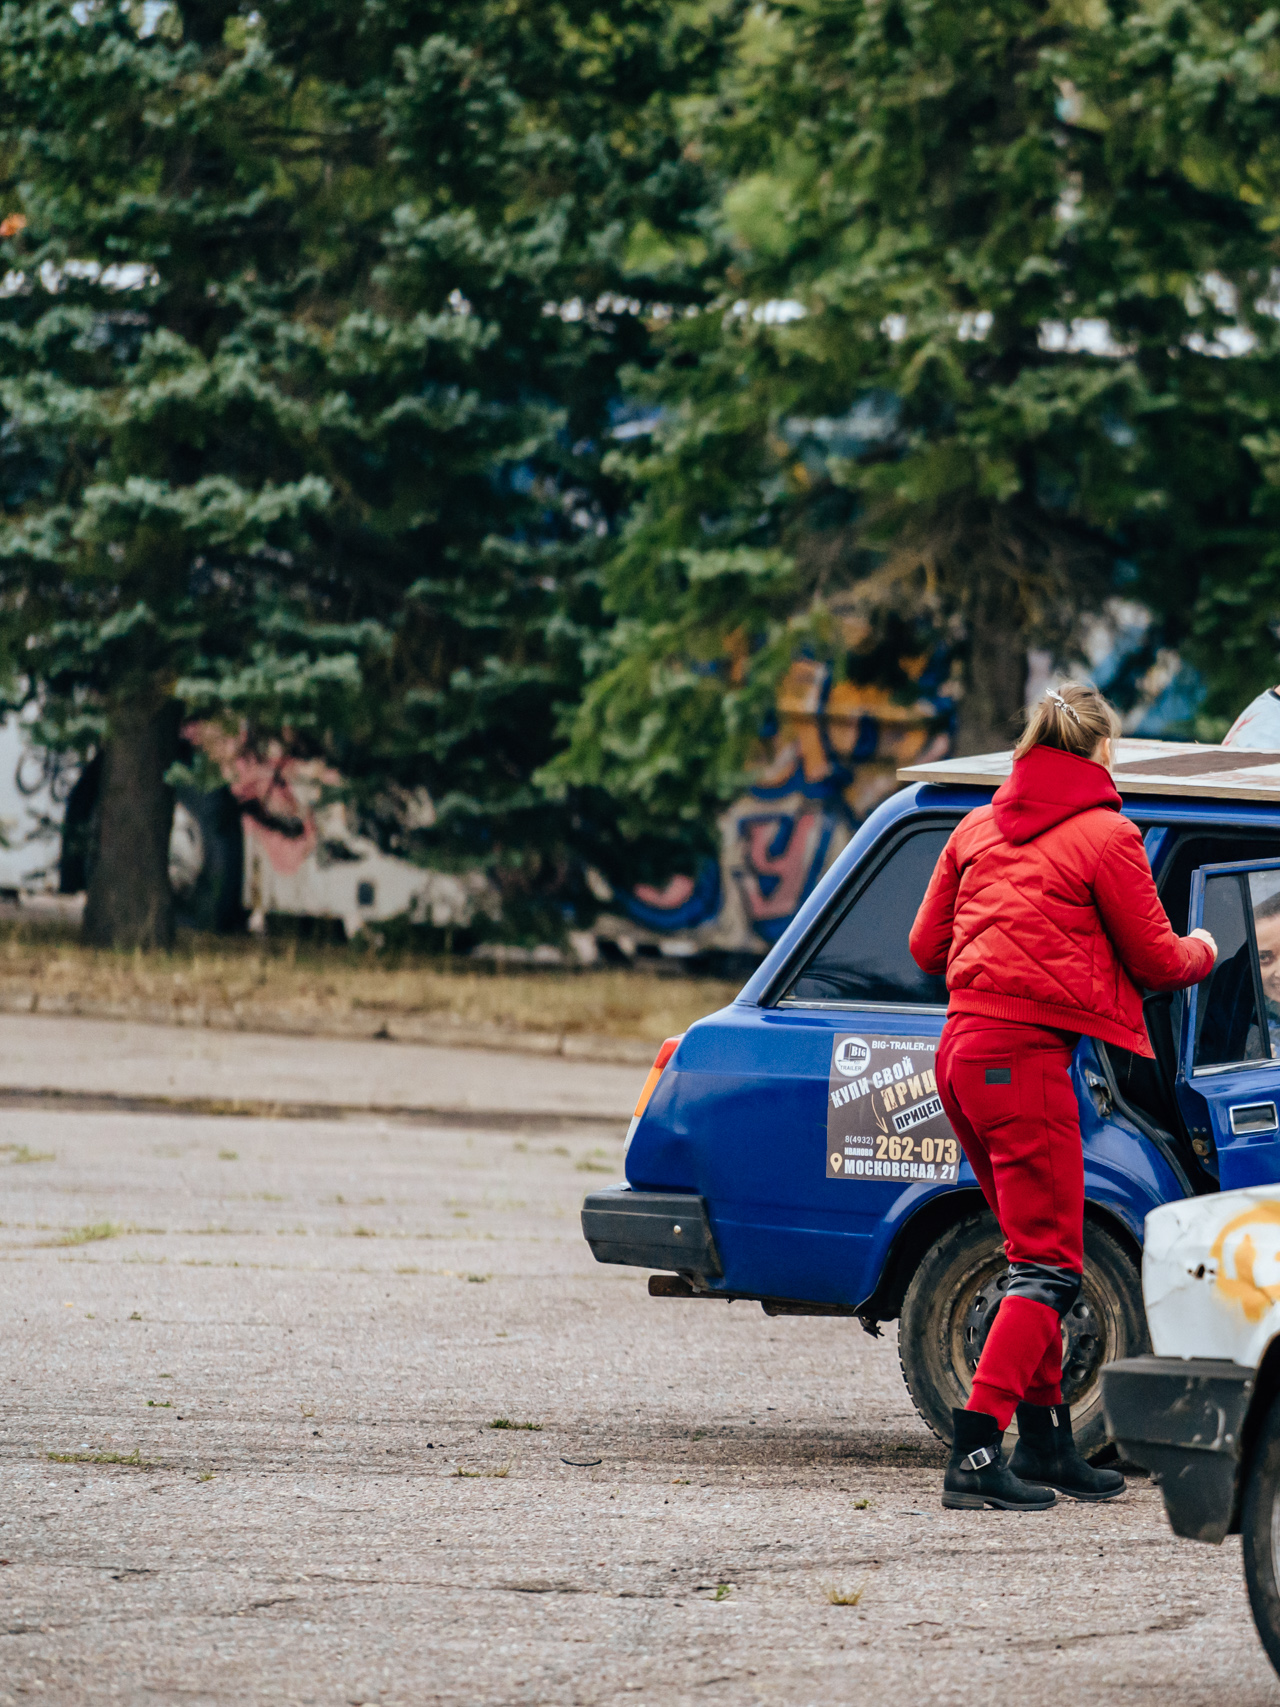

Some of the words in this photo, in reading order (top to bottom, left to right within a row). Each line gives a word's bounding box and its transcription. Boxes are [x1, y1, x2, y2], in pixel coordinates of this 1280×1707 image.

[851, 1045, 866, 1057] BIG
[871, 1040, 935, 1052] BIG-TRAILER.ru
[830, 1076, 870, 1108] КУПИ
[872, 1056, 914, 1089] СВОЙ
[895, 1099, 942, 1129] ПРИЦЕП
[844, 1135, 874, 1145] 8(4932)
[876, 1135, 957, 1163] 262-073
[844, 1147, 874, 1156] ИВАНОВО
[844, 1159, 937, 1180] МОСКОВСКАЯ,
[940, 1165, 956, 1179] 21
